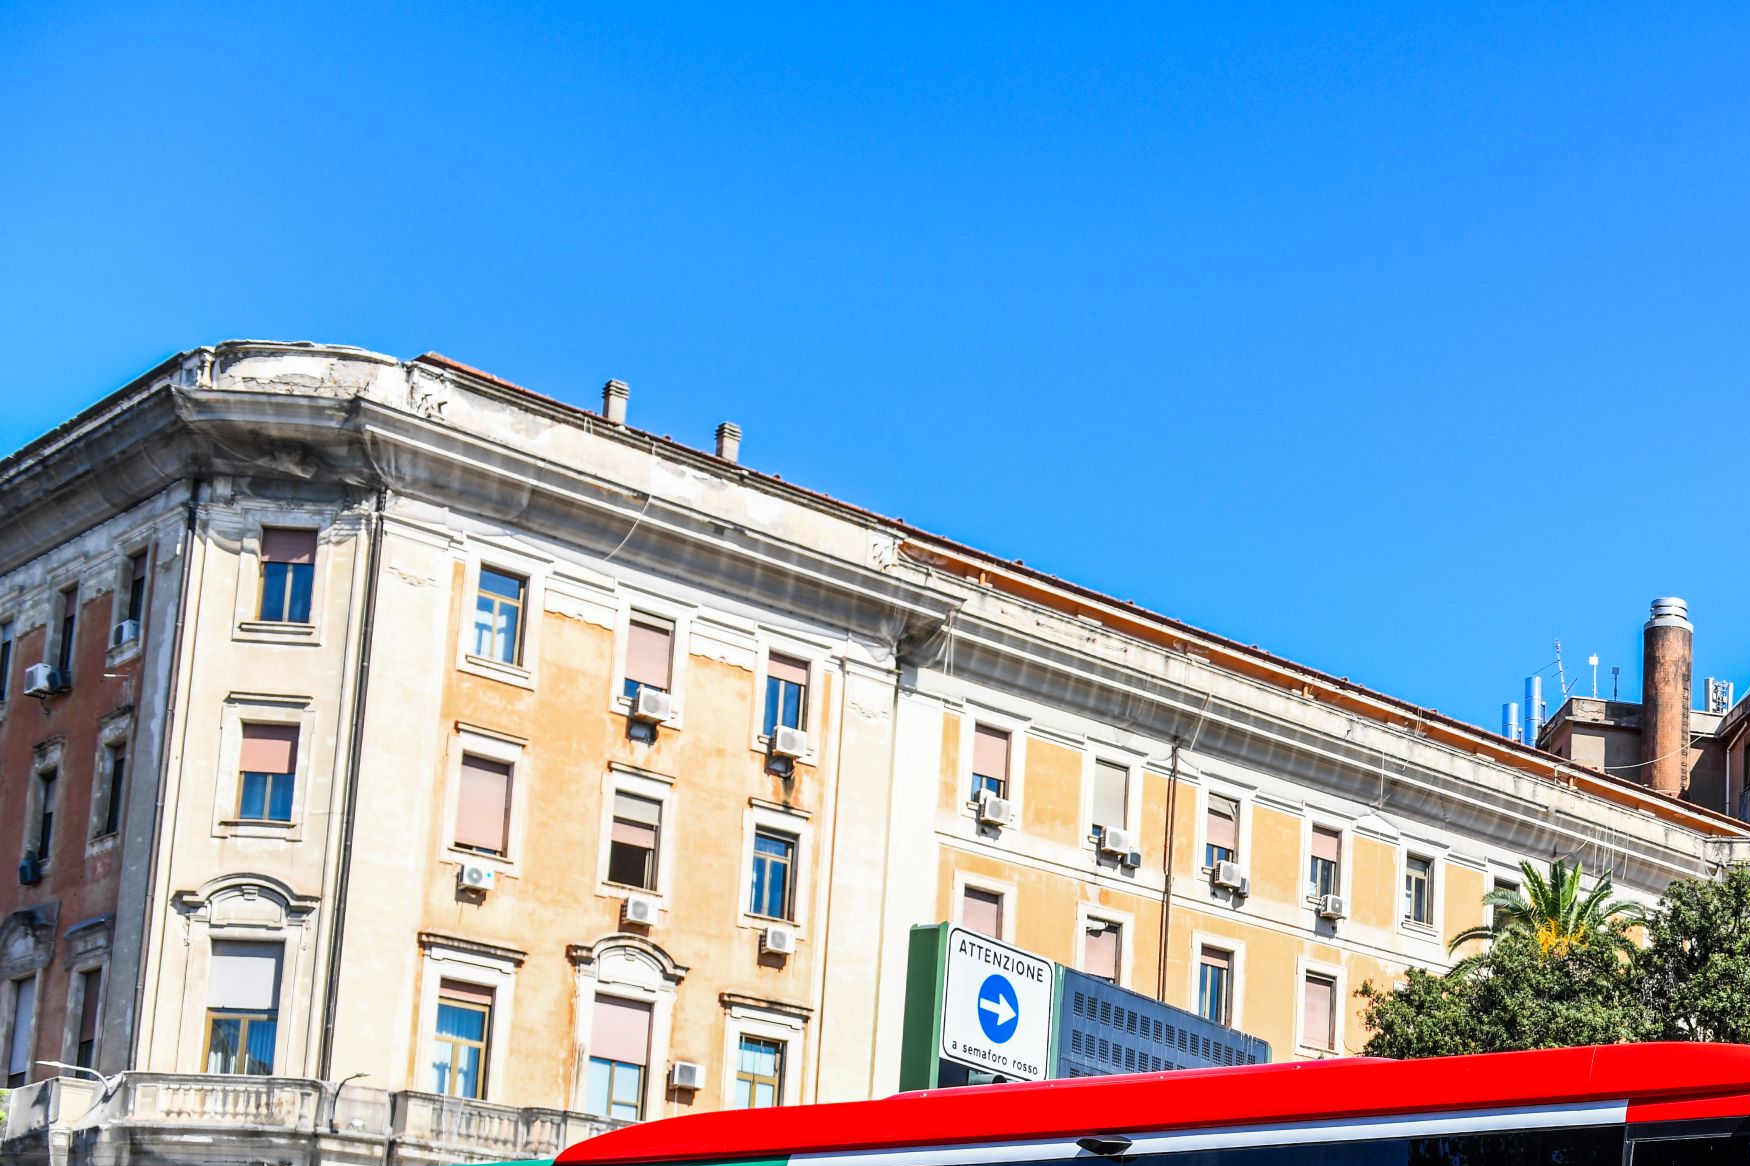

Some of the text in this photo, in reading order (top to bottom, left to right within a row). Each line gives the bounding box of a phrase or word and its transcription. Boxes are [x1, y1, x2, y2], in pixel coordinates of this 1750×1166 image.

[958, 938, 1045, 984] ATTENZIONE
[951, 1040, 1038, 1076] a semaforo rosso
